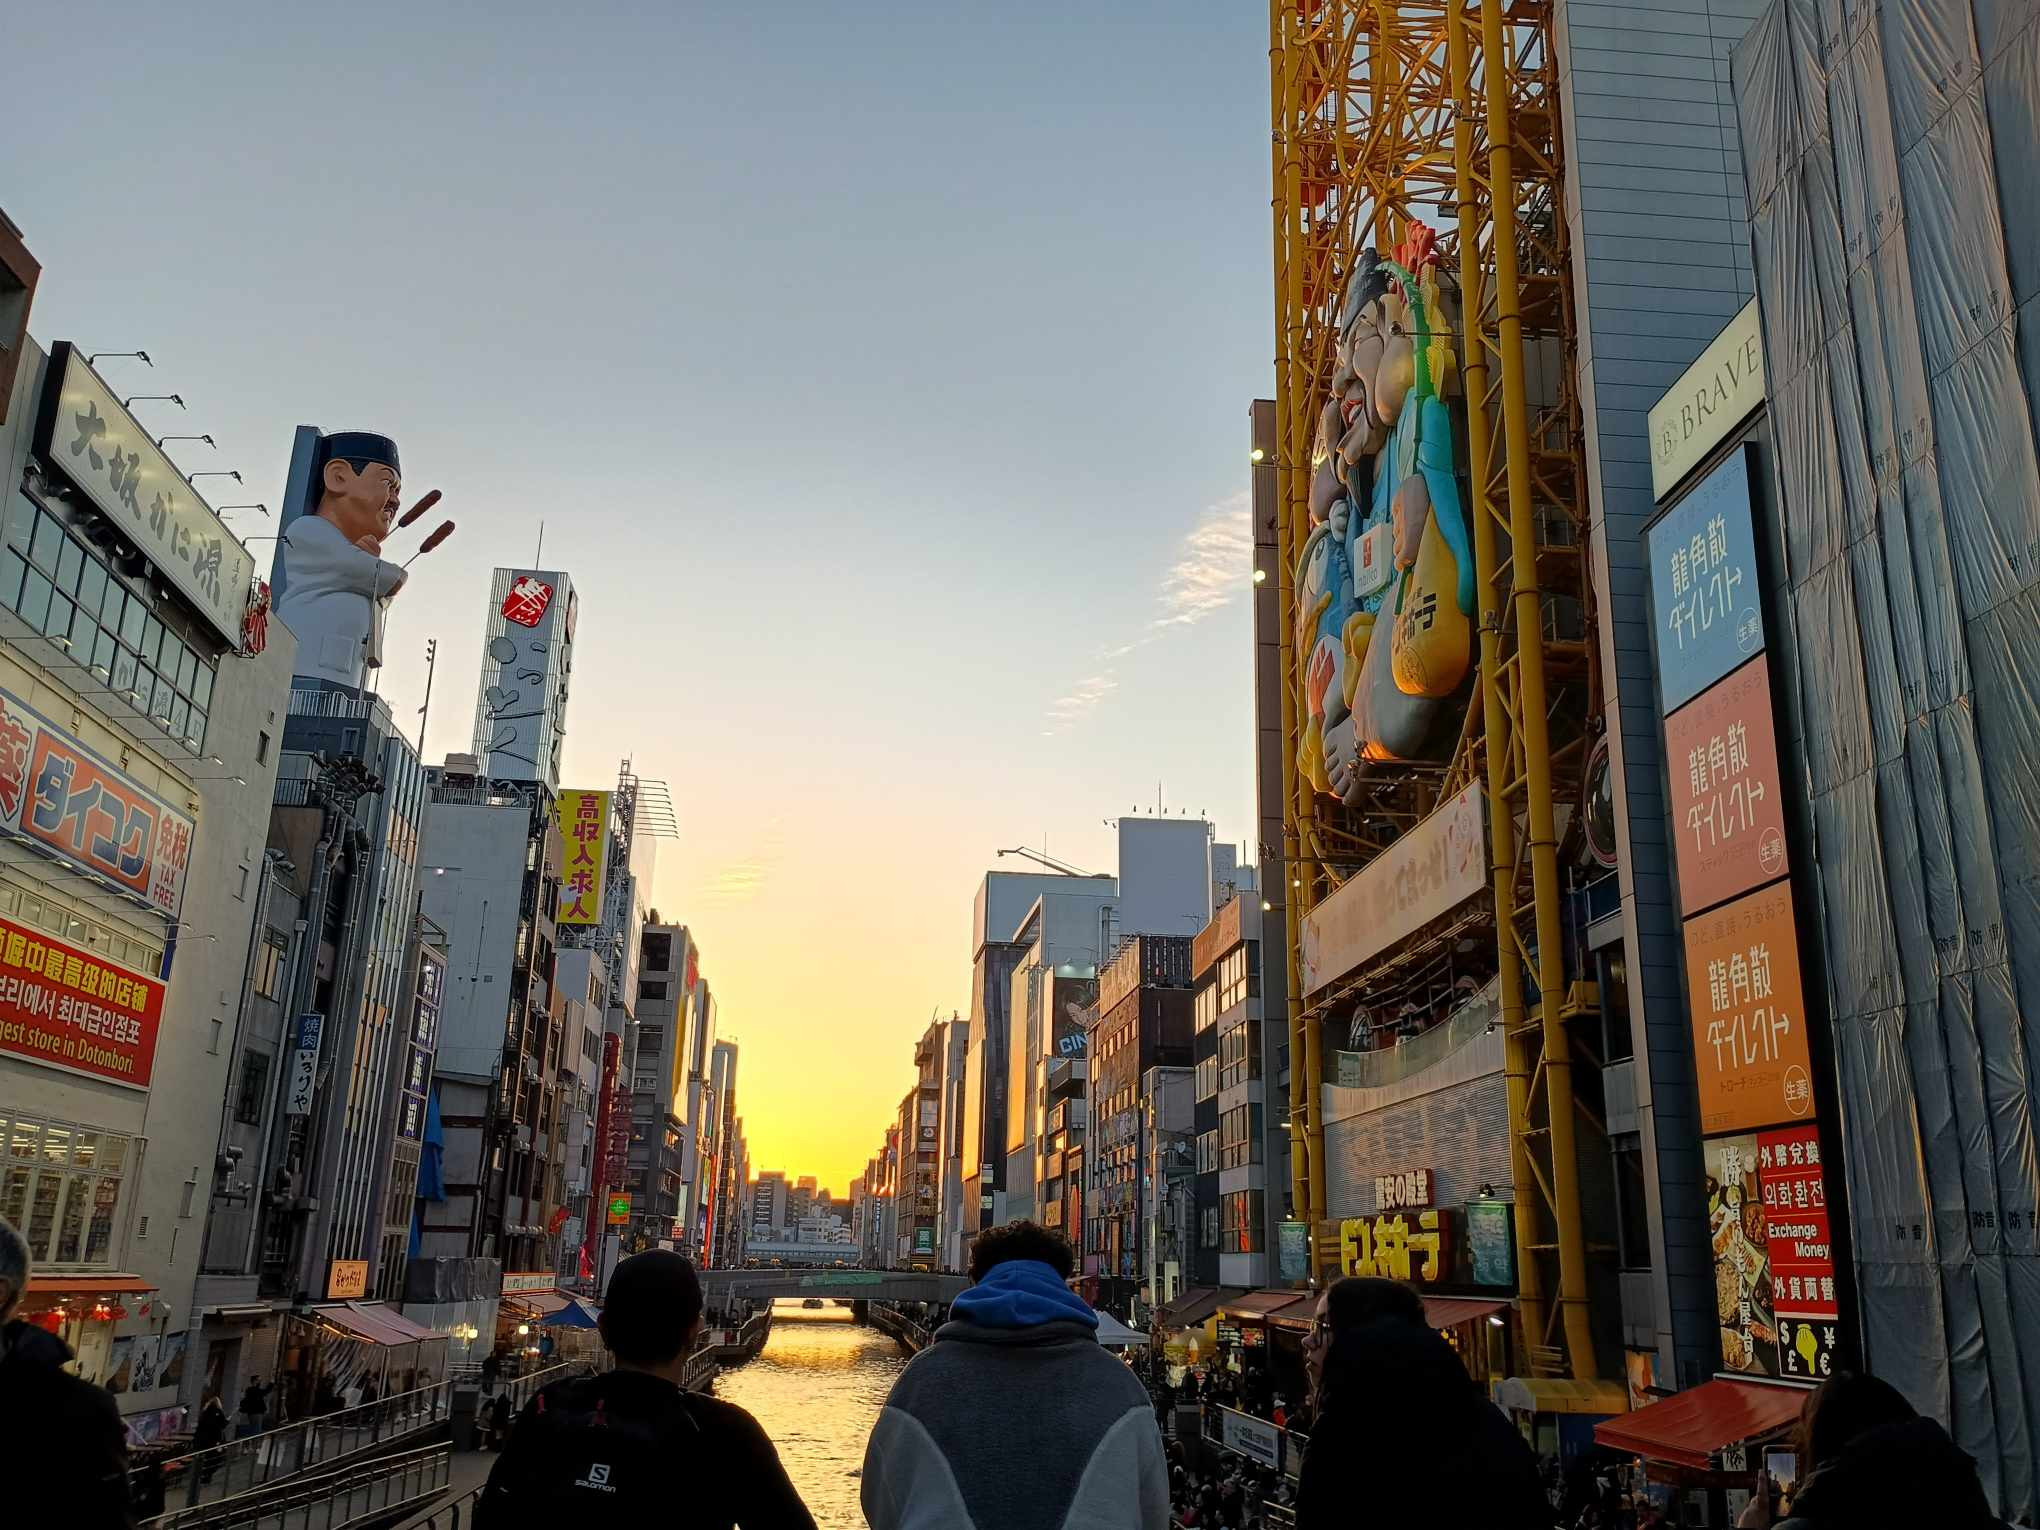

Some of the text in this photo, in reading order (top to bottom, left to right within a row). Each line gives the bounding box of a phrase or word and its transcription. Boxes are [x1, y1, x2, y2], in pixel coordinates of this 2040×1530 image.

[1681, 334, 1760, 441] BRAVE
[1671, 512, 1728, 599] 龍角散
[1669, 565, 1744, 650] ダイレクト
[1688, 720, 1750, 799] 龍角散
[32, 751, 153, 878] ダイコク
[1686, 777, 1765, 853] ダイレクト
[157, 814, 189, 871] 免税
[567, 793, 600, 918] 高収入求人
[1760, 838, 1783, 864] 生薬
[153, 882, 175, 910] FREE
[160, 864, 177, 887] TAX
[1708, 943, 1773, 1013] 龍角散
[57, 994, 142, 1045] 최대급인점포
[302, 1018, 320, 1048] 焼肉
[1707, 1006, 1791, 1072] ダイレクト
[27, 1028, 60, 1053] store
[63, 1034, 75, 1058] in
[78, 1038, 135, 1075] Dotonbori.
[294, 1051, 314, 1112] いろりや
[1786, 1079, 1808, 1101] 生薬
[1761, 1141, 1821, 1169] 外幣兌換
[1764, 1178, 1824, 1211] 외화환전
[1768, 1222, 1818, 1241] Exchange
[1795, 1241, 1830, 1259] Money
[1774, 1276, 1834, 1301] 外貨両替
